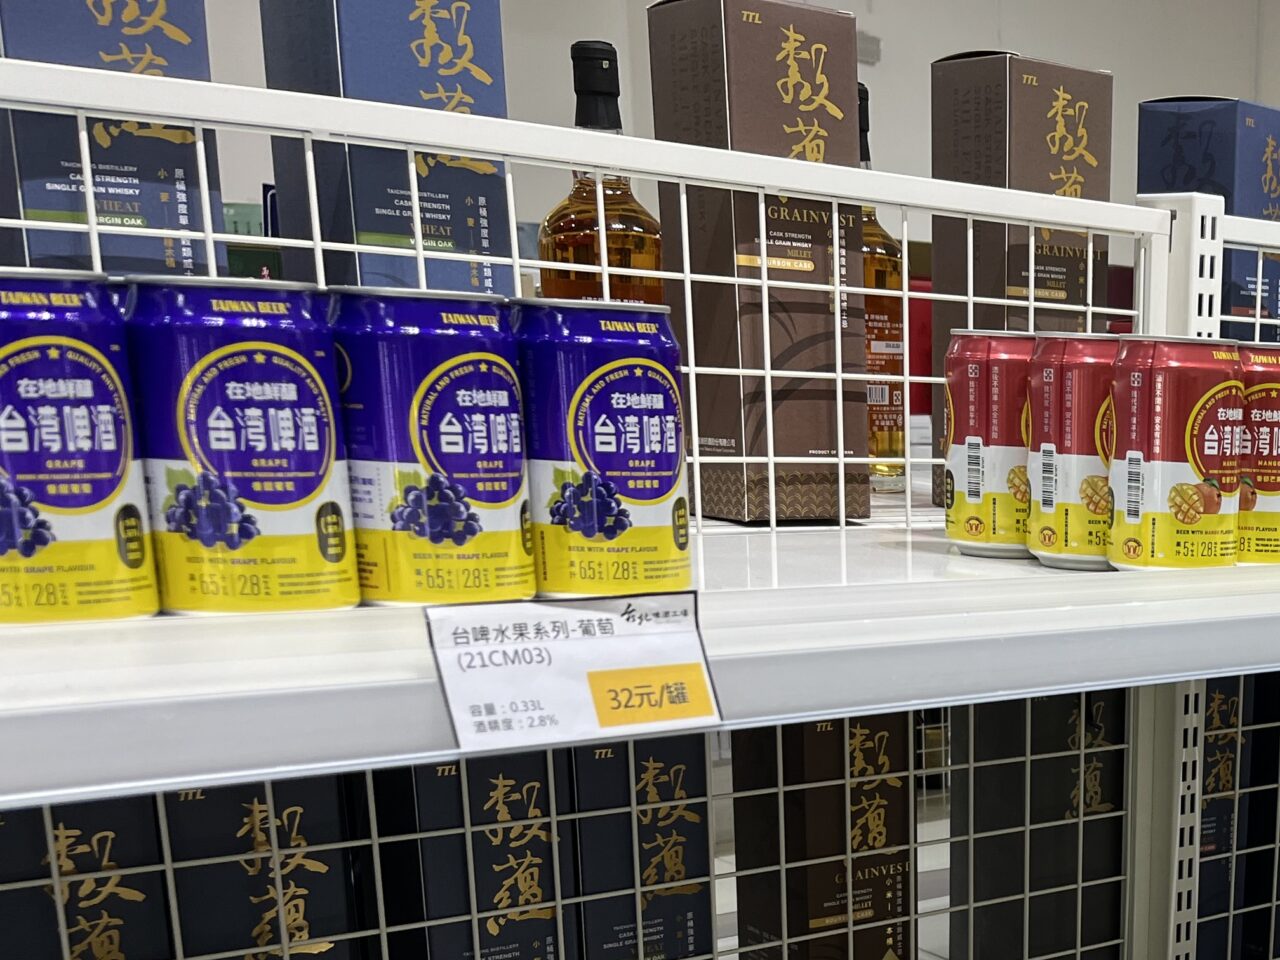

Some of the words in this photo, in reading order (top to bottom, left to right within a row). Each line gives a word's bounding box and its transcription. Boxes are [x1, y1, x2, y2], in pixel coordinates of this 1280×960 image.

[95, 175, 139, 184] STRENGTH
[45, 183, 77, 192] SINGLE
[107, 186, 141, 196] WHISKY
[375, 208, 400, 216] SINGLE
[425, 213, 451, 221] WHISKY
[768, 206, 855, 228] GRAINVST
[123, 217, 143, 226] OAK
[784, 232, 812, 240] STRENGTH
[438, 240, 453, 248] OAK
[50, 293, 82, 307] BEER
[258, 302, 288, 314] BEER
[440, 312, 480, 326] TAIWAN
[599, 320, 636, 333] TAIWAN
[638, 321, 657, 334] BEER
[1250, 354, 1276, 364] TAIWAN
[606, 369, 629, 384] FRESH
[46, 459, 85, 469] GRAPE
[251, 459, 289, 468] GRAPE
[476, 460, 503, 469] GRAPE
[629, 460, 656, 469] GRAPE
[456, 552, 480, 561] GRAPE
[452, 618, 615, 647] 台啤水果系列-葡萄
[457, 648, 552, 673] (21CM03)
[607, 682, 689, 711] 32元/罐
